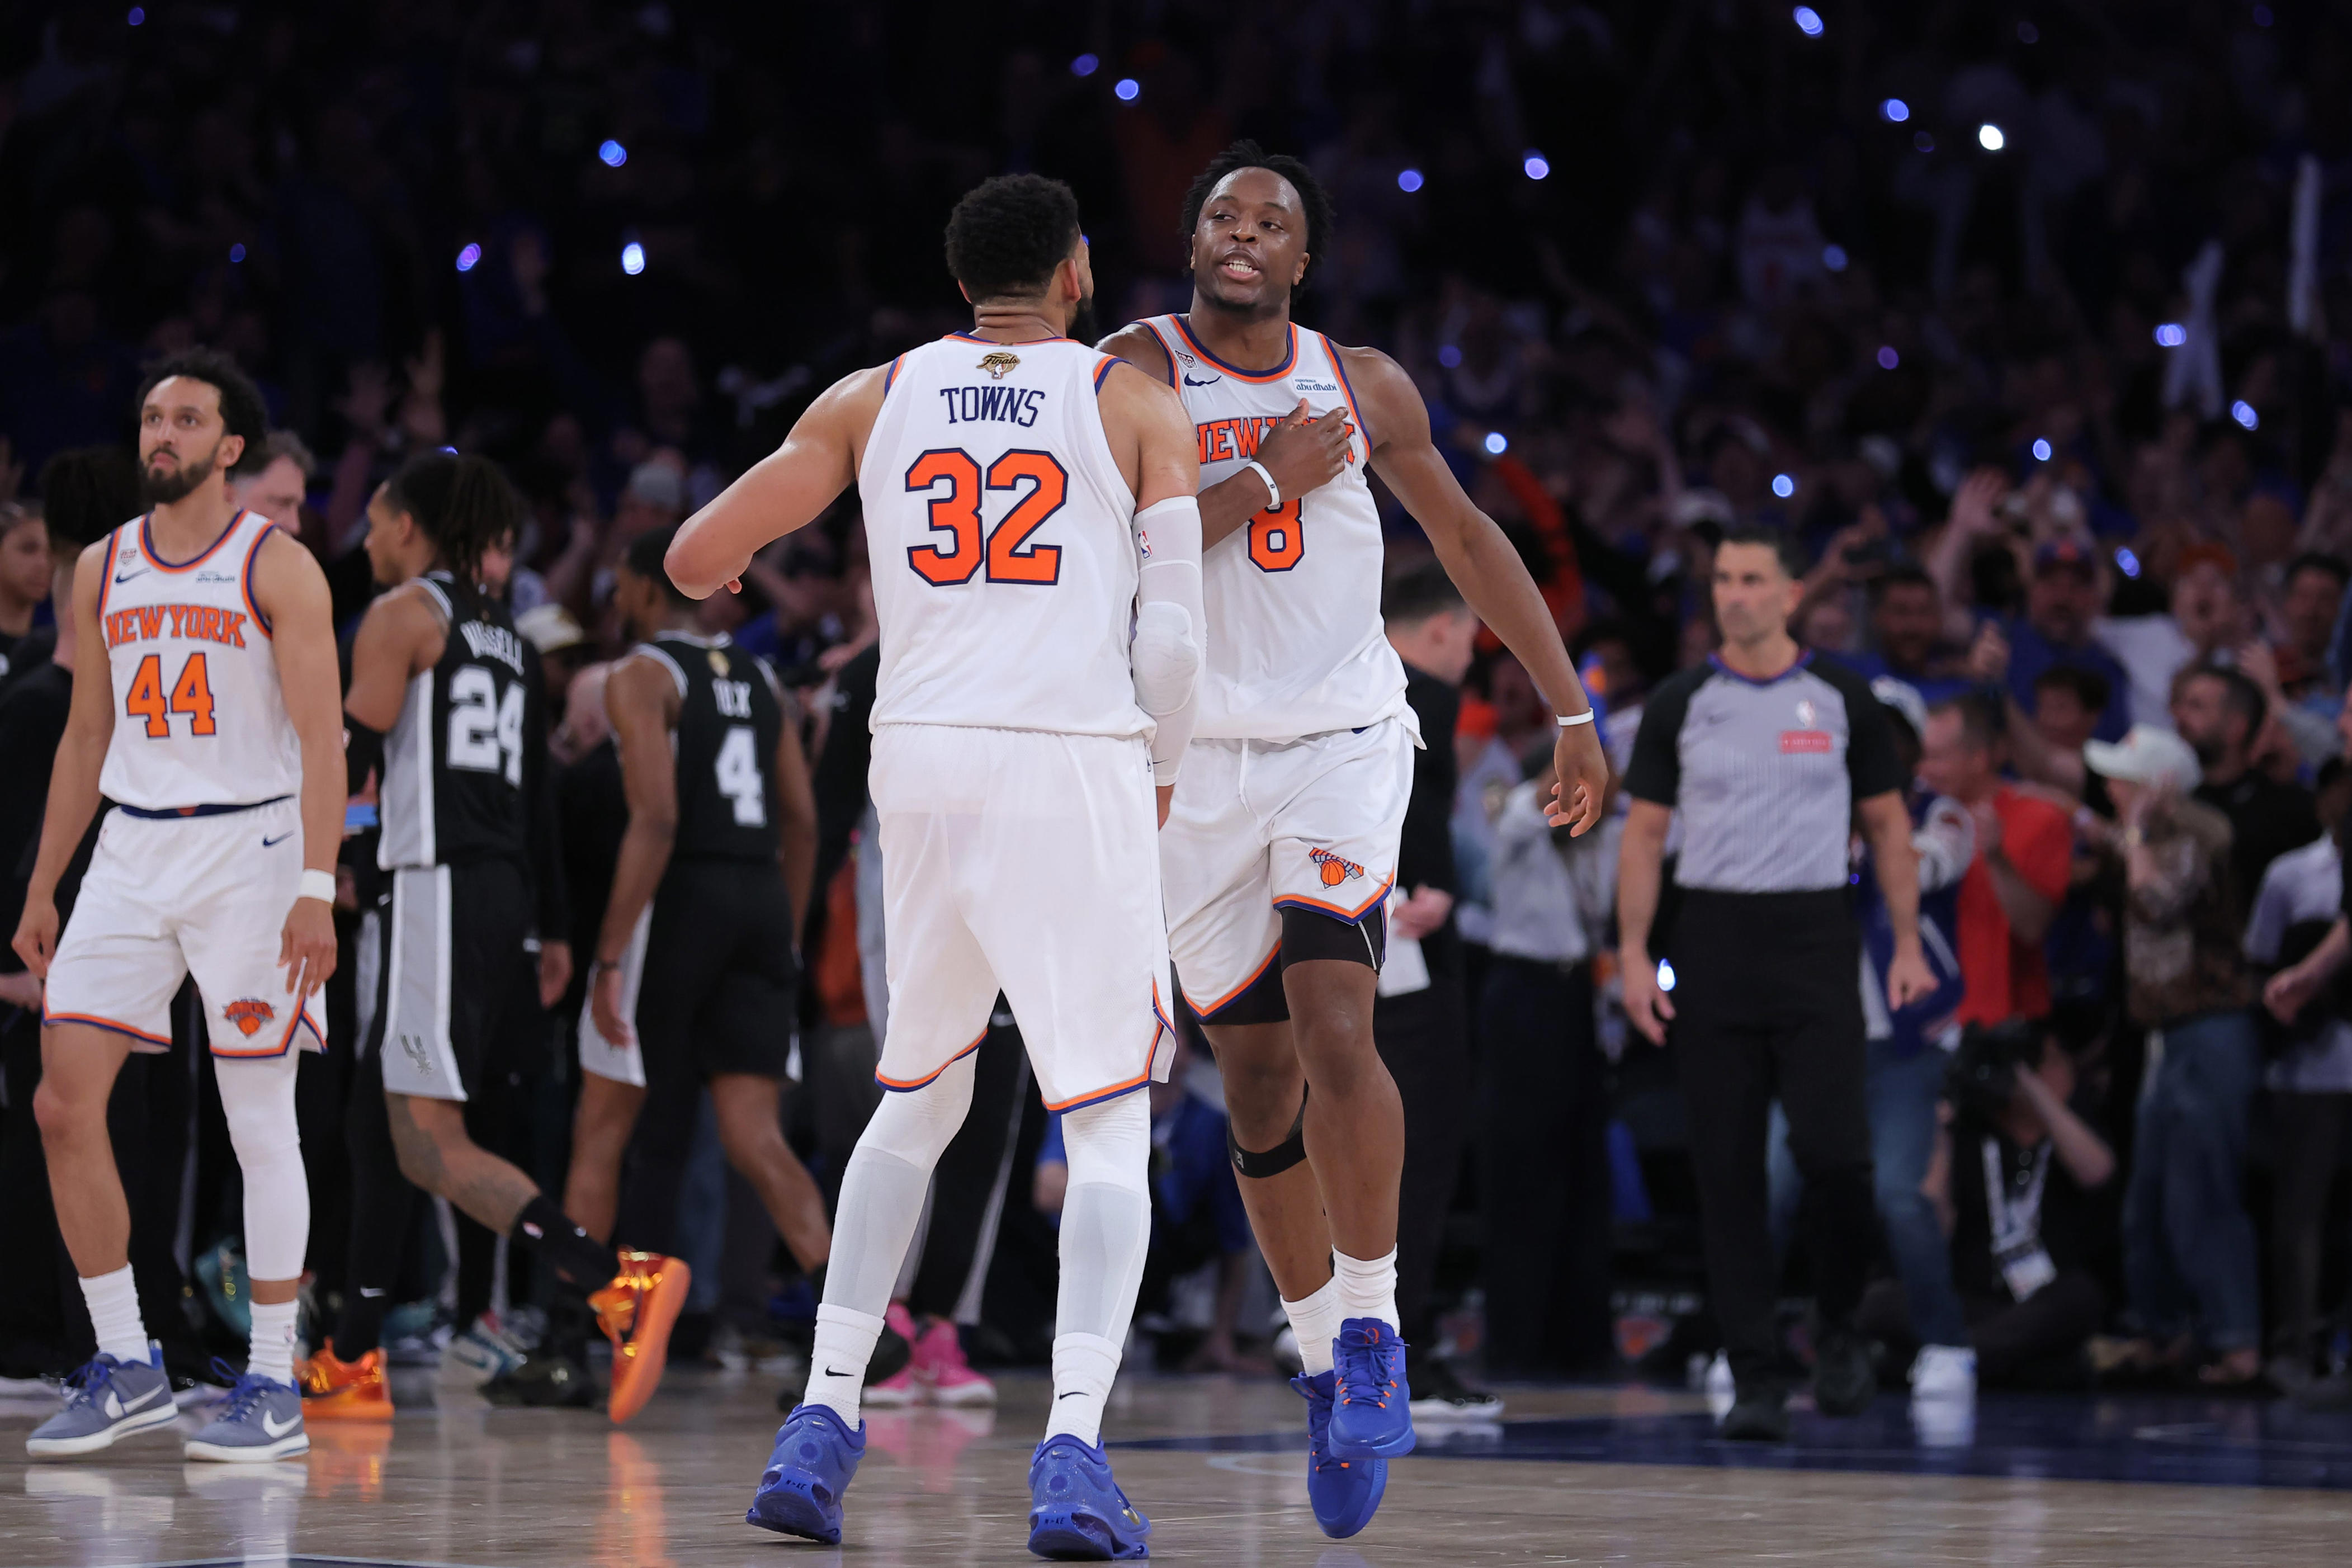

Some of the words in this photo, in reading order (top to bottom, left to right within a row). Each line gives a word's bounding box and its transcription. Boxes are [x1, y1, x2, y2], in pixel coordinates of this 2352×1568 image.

[977, 355, 1018, 367] Finals
[940, 386, 1045, 427] TOWNS
[905, 447, 1069, 587] 32
[1248, 497, 1305, 573] 8
[106, 605, 167, 649] NEW
[168, 603, 246, 650] YORK
[126, 652, 216, 738] 44
[446, 663, 526, 790] 24
[714, 725, 767, 828] 4
